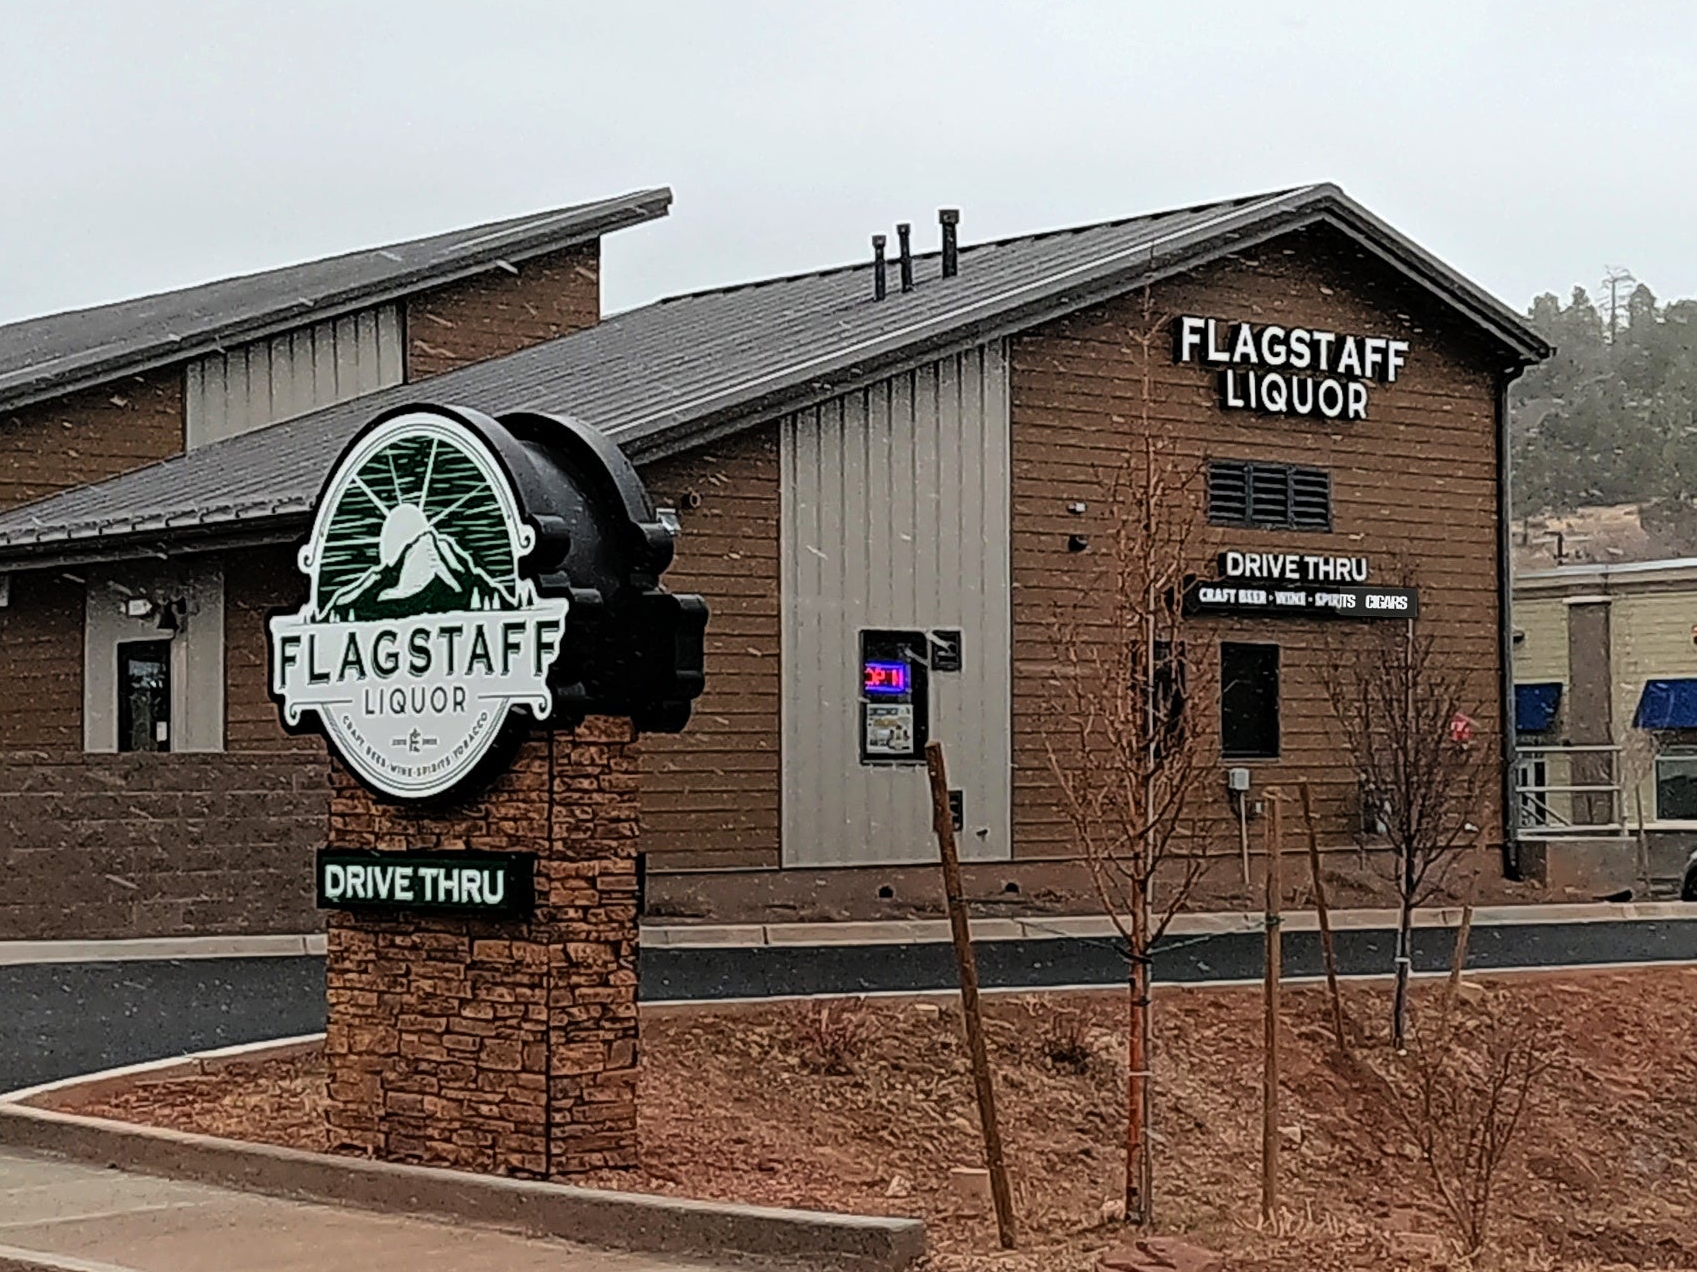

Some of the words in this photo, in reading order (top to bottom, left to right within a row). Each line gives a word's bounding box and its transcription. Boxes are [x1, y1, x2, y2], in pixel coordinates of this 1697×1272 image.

[1180, 315, 1409, 382] FLAGSTAFF
[1226, 369, 1369, 419] LIQUOR
[1226, 552, 1300, 579] DRIVE
[1304, 556, 1367, 582] THRU
[1198, 587, 1237, 604] CRAFT
[1238, 589, 1267, 605] BEER
[1274, 590, 1306, 606] WINE
[1365, 594, 1408, 610] CIGARS
[278, 619, 562, 689] FLAGSTAFF
[364, 685, 467, 716] LIQUOR
[342, 715, 366, 747] CRAFT
[453, 712, 488, 760] TOBACCO
[324, 863, 413, 901] DRIVE
[418, 866, 504, 903] THRU
